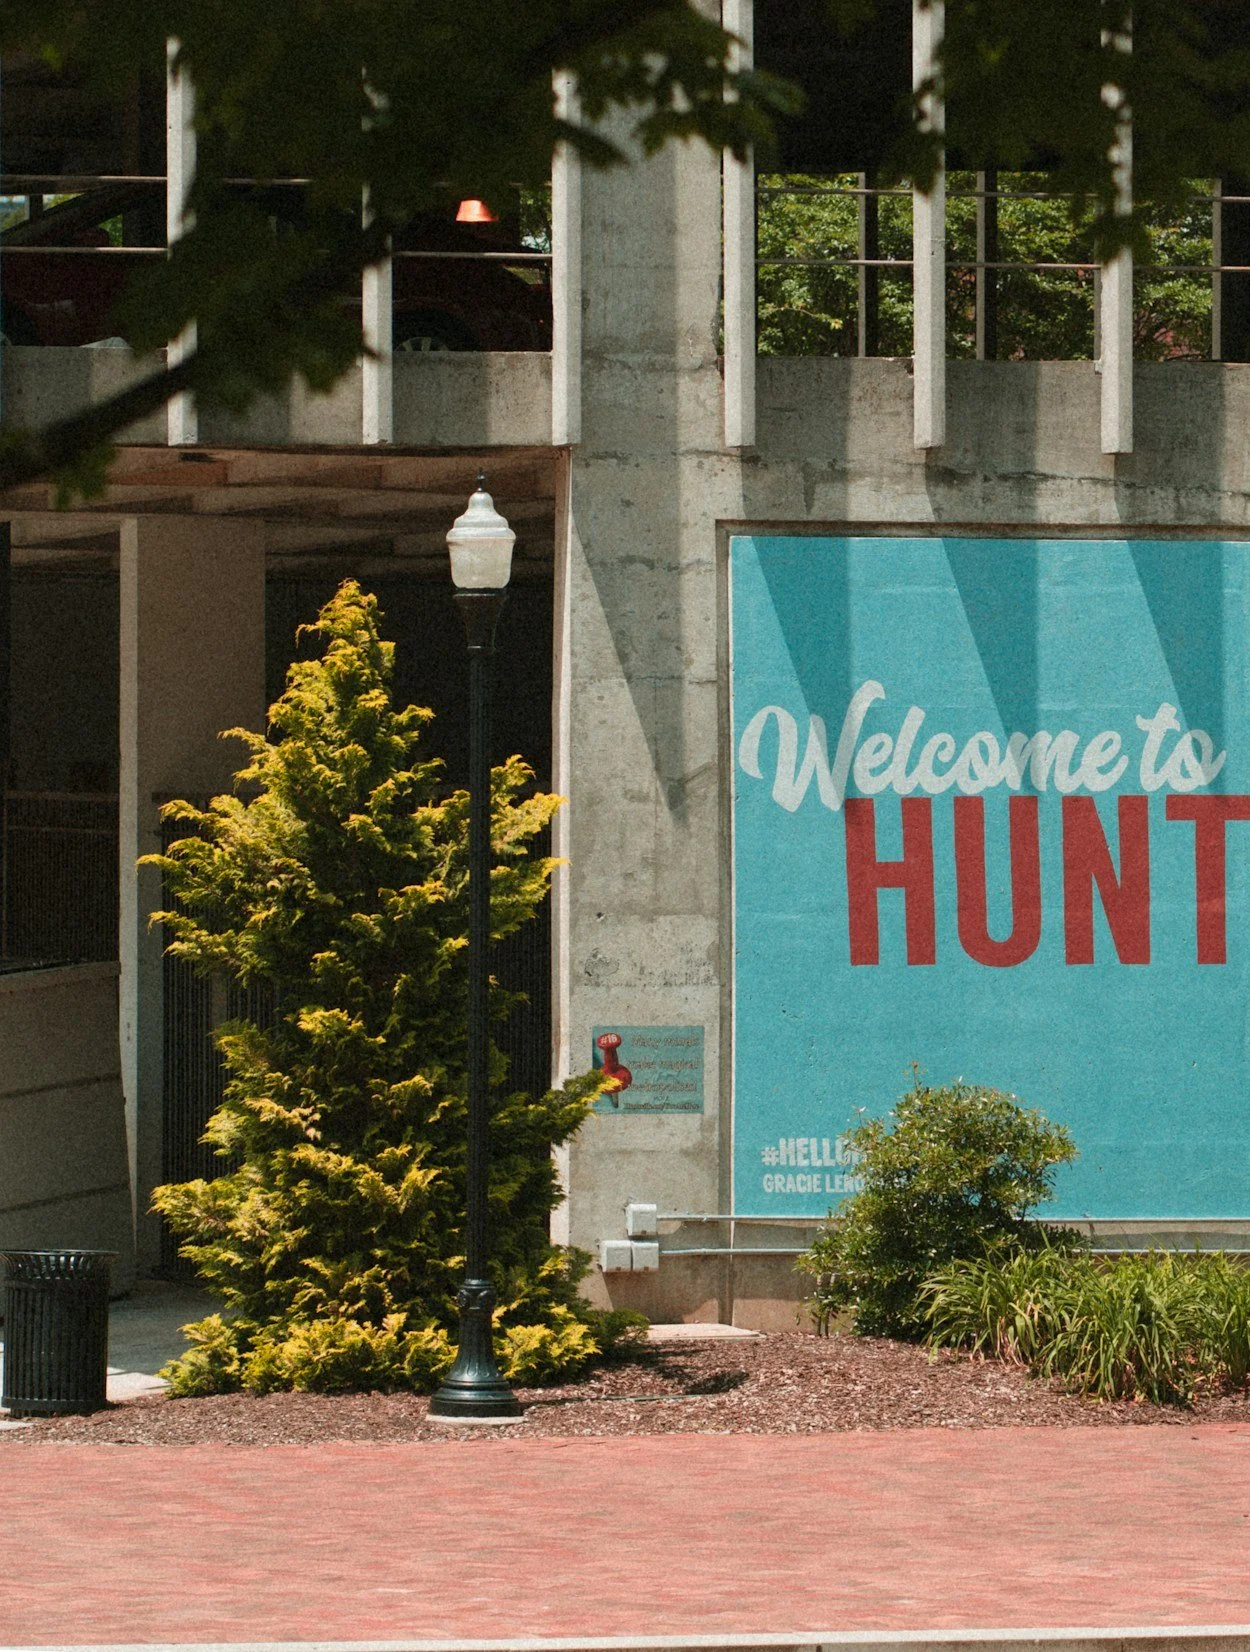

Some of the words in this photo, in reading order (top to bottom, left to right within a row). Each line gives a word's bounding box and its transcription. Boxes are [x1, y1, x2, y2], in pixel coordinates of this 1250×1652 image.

[738, 679, 1129, 812] Welcome
[1136, 702, 1226, 792] to
[763, 1173, 822, 1193] GRACIE
[825, 1174, 866, 1193] LENO
